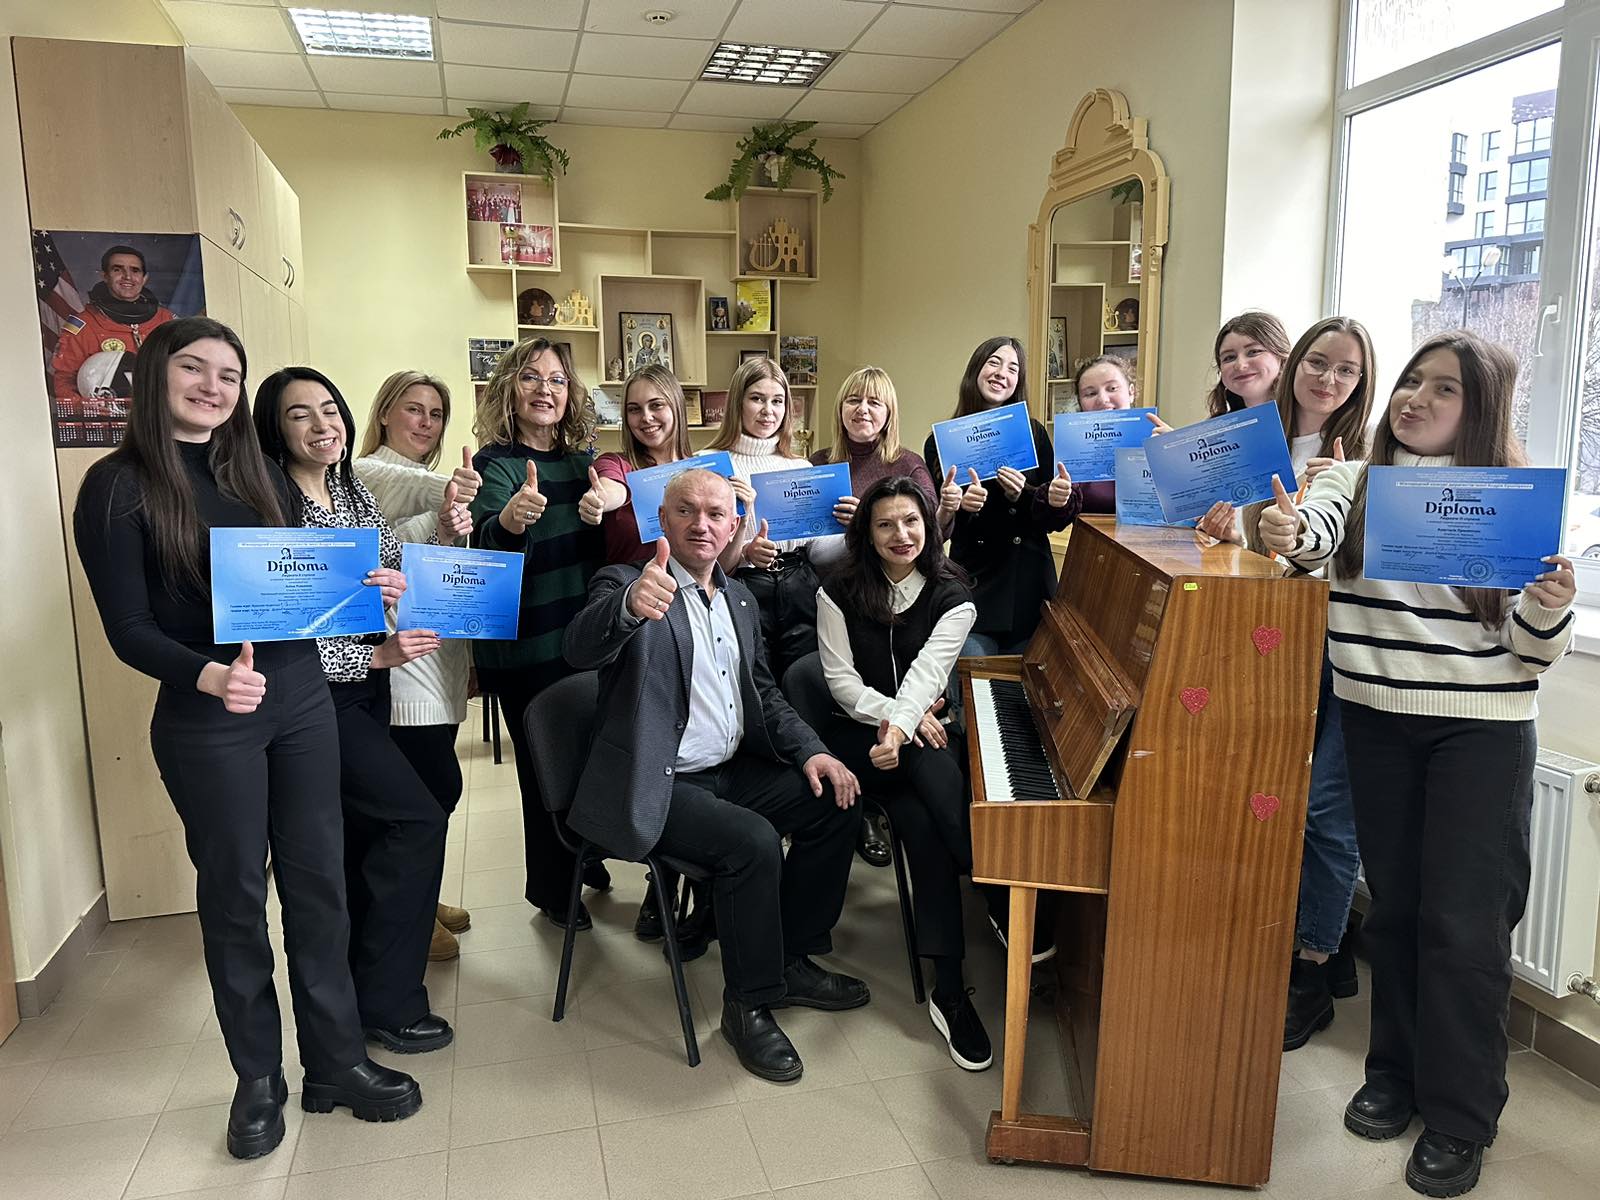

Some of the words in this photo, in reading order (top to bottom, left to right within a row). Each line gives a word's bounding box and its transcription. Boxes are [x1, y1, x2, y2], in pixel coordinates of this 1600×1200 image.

[965, 429, 1002, 443] Diploma
[1084, 431, 1122, 440] Diploma
[1188, 442, 1241, 462] Diploma
[783, 488, 821, 499] Diploma
[1425, 501, 1497, 517] Diploma
[267, 560, 329, 574] Diploma
[442, 573, 487, 586] Diploma
